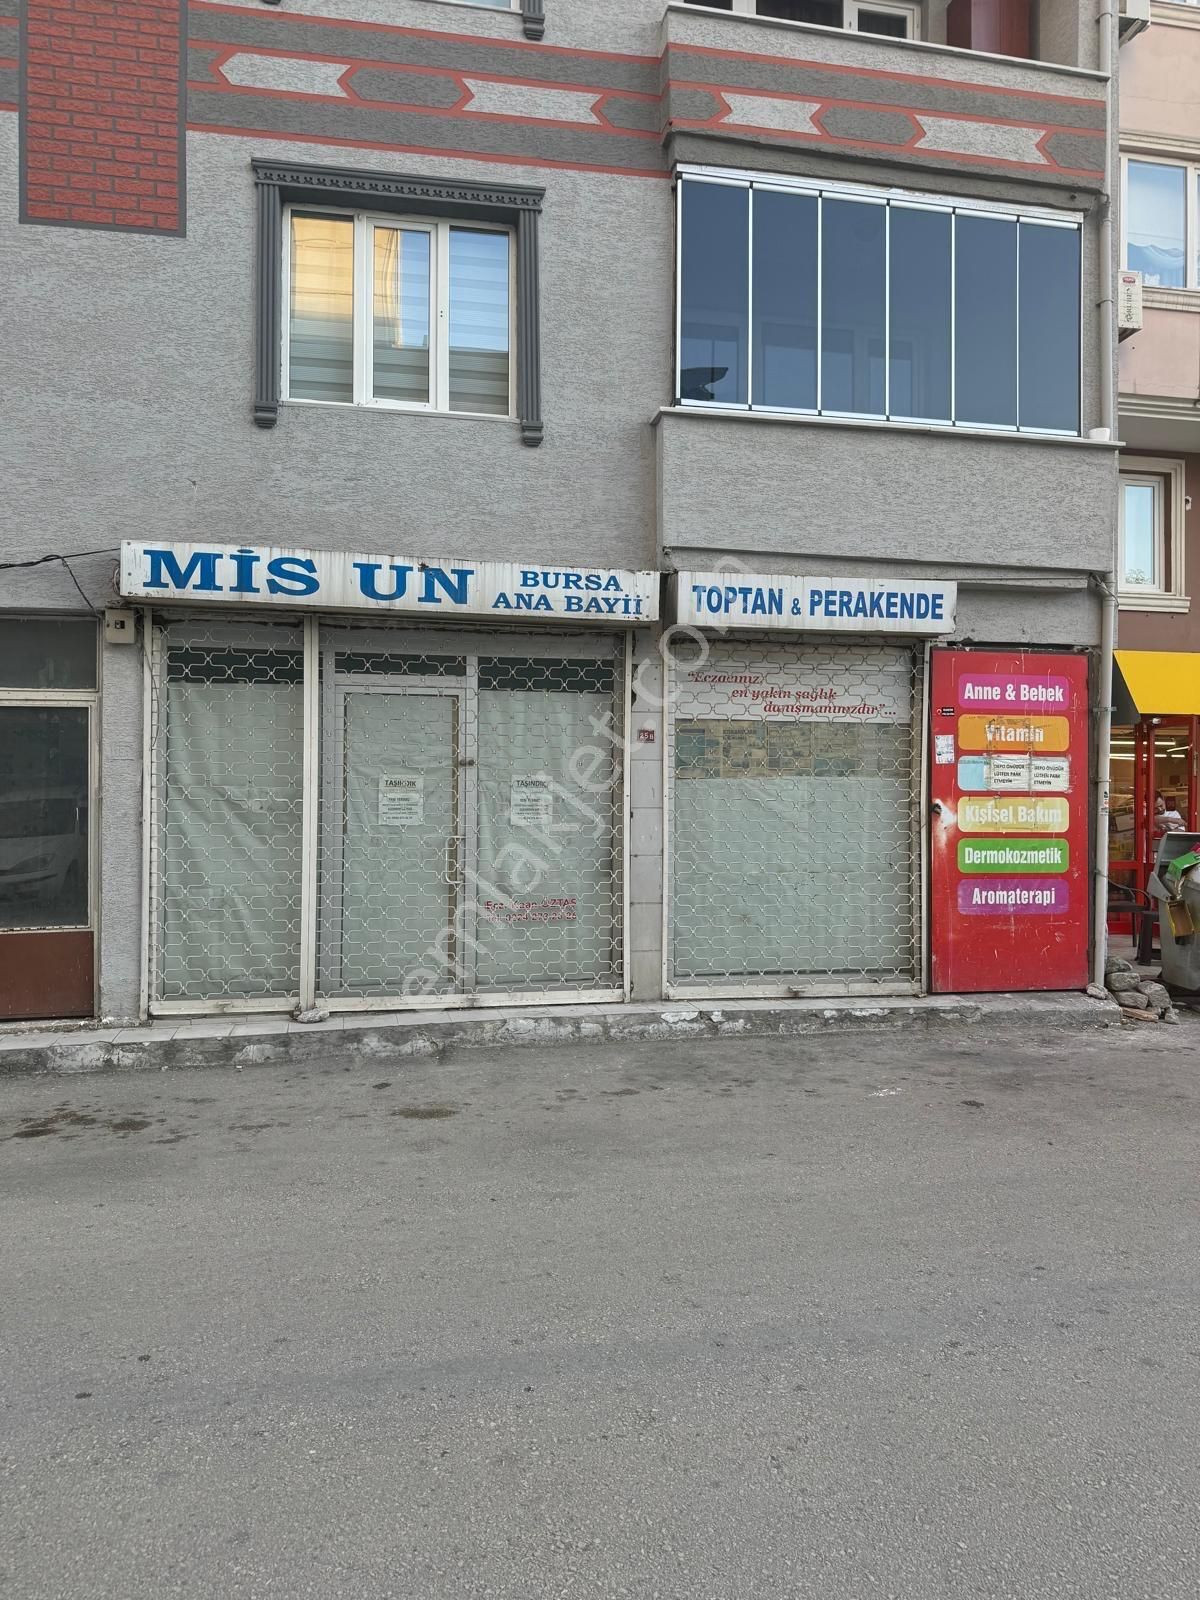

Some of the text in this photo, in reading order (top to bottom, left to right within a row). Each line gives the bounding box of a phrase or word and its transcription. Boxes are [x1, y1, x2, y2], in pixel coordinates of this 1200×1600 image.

[143, 549, 475, 605] MİS UN
[520, 570, 623, 592] BURSA
[492, 592, 643, 615] ANA BAYİİ
[692, 585, 944, 620] TOPTAN & PERAKENDE
[731, 688, 749, 699] en
[751, 686, 791, 700] yakın
[964, 683, 1064, 702] Anne & Bebek
[985, 724, 1044, 742] Vitamin
[965, 805, 1062, 824] Kişisel Bakım
[964, 847, 1062, 864] Dermokozmetik
[972, 887, 1056, 906] Aromaterapi
